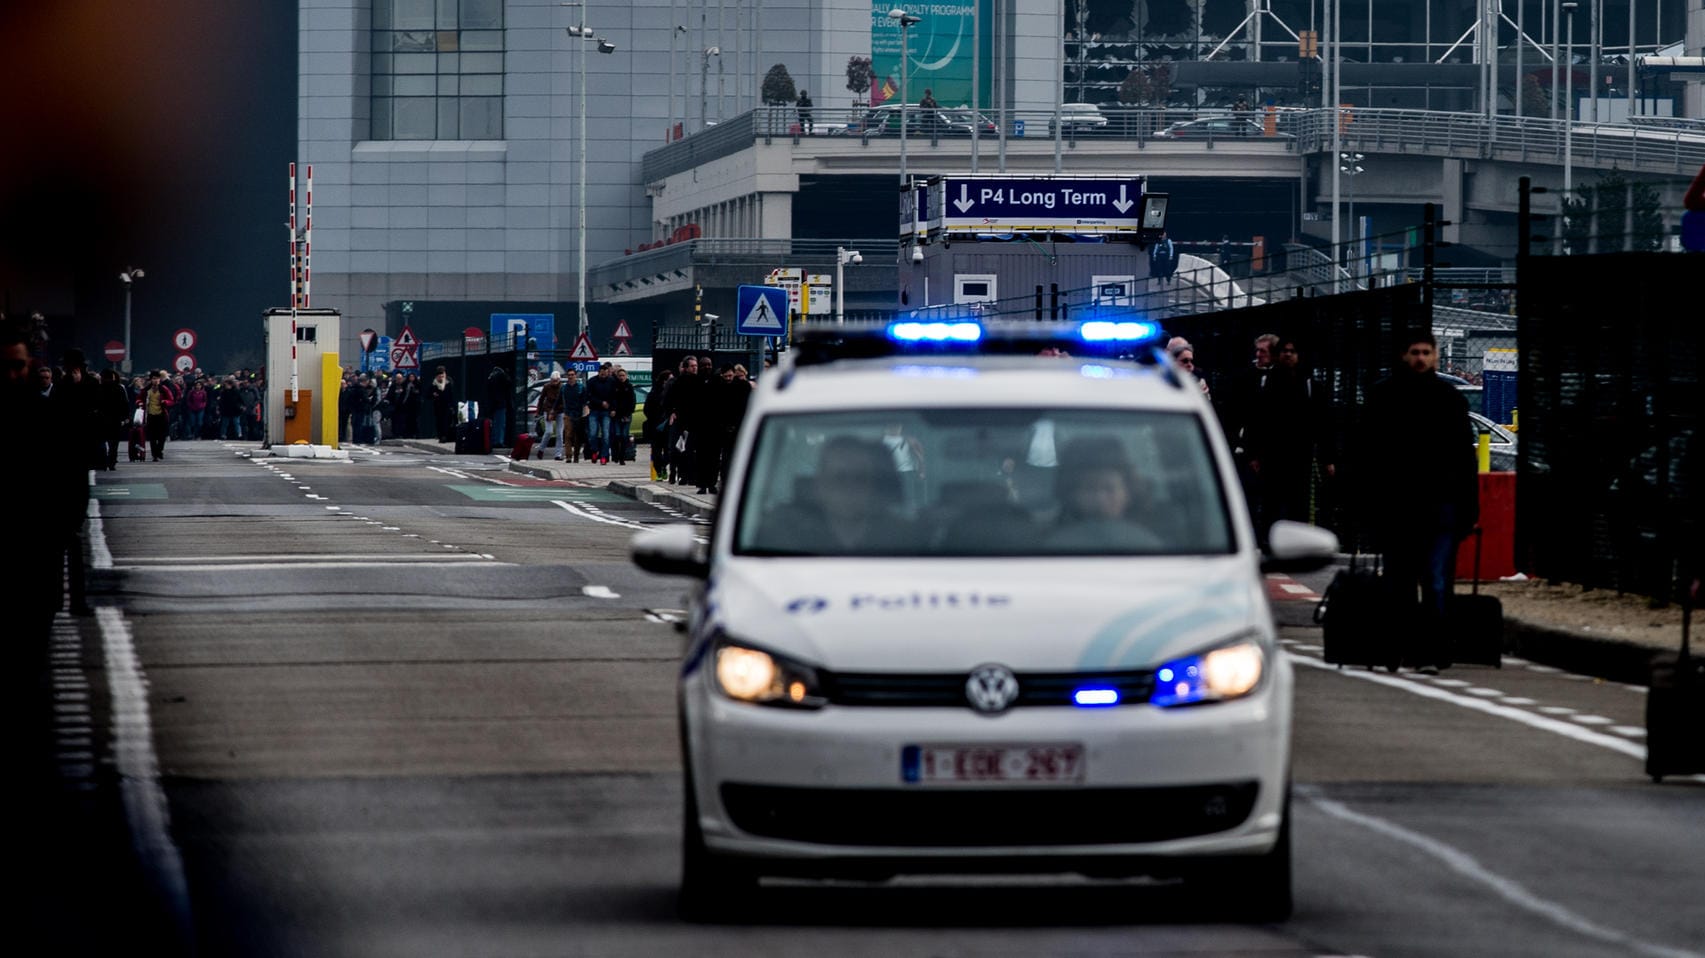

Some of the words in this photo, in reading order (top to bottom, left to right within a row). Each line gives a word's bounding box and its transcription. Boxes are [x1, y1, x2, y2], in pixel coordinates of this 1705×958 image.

[872, 3, 891, 14] ALLY
[981, 188, 1004, 205] P4
[1010, 188, 1055, 209] Long
[1061, 188, 1106, 205] Term
[507, 319, 527, 352] P
[572, 362, 584, 372] 30
[627, 374, 653, 382] RMINAL
[850, 591, 1010, 609] Politie
